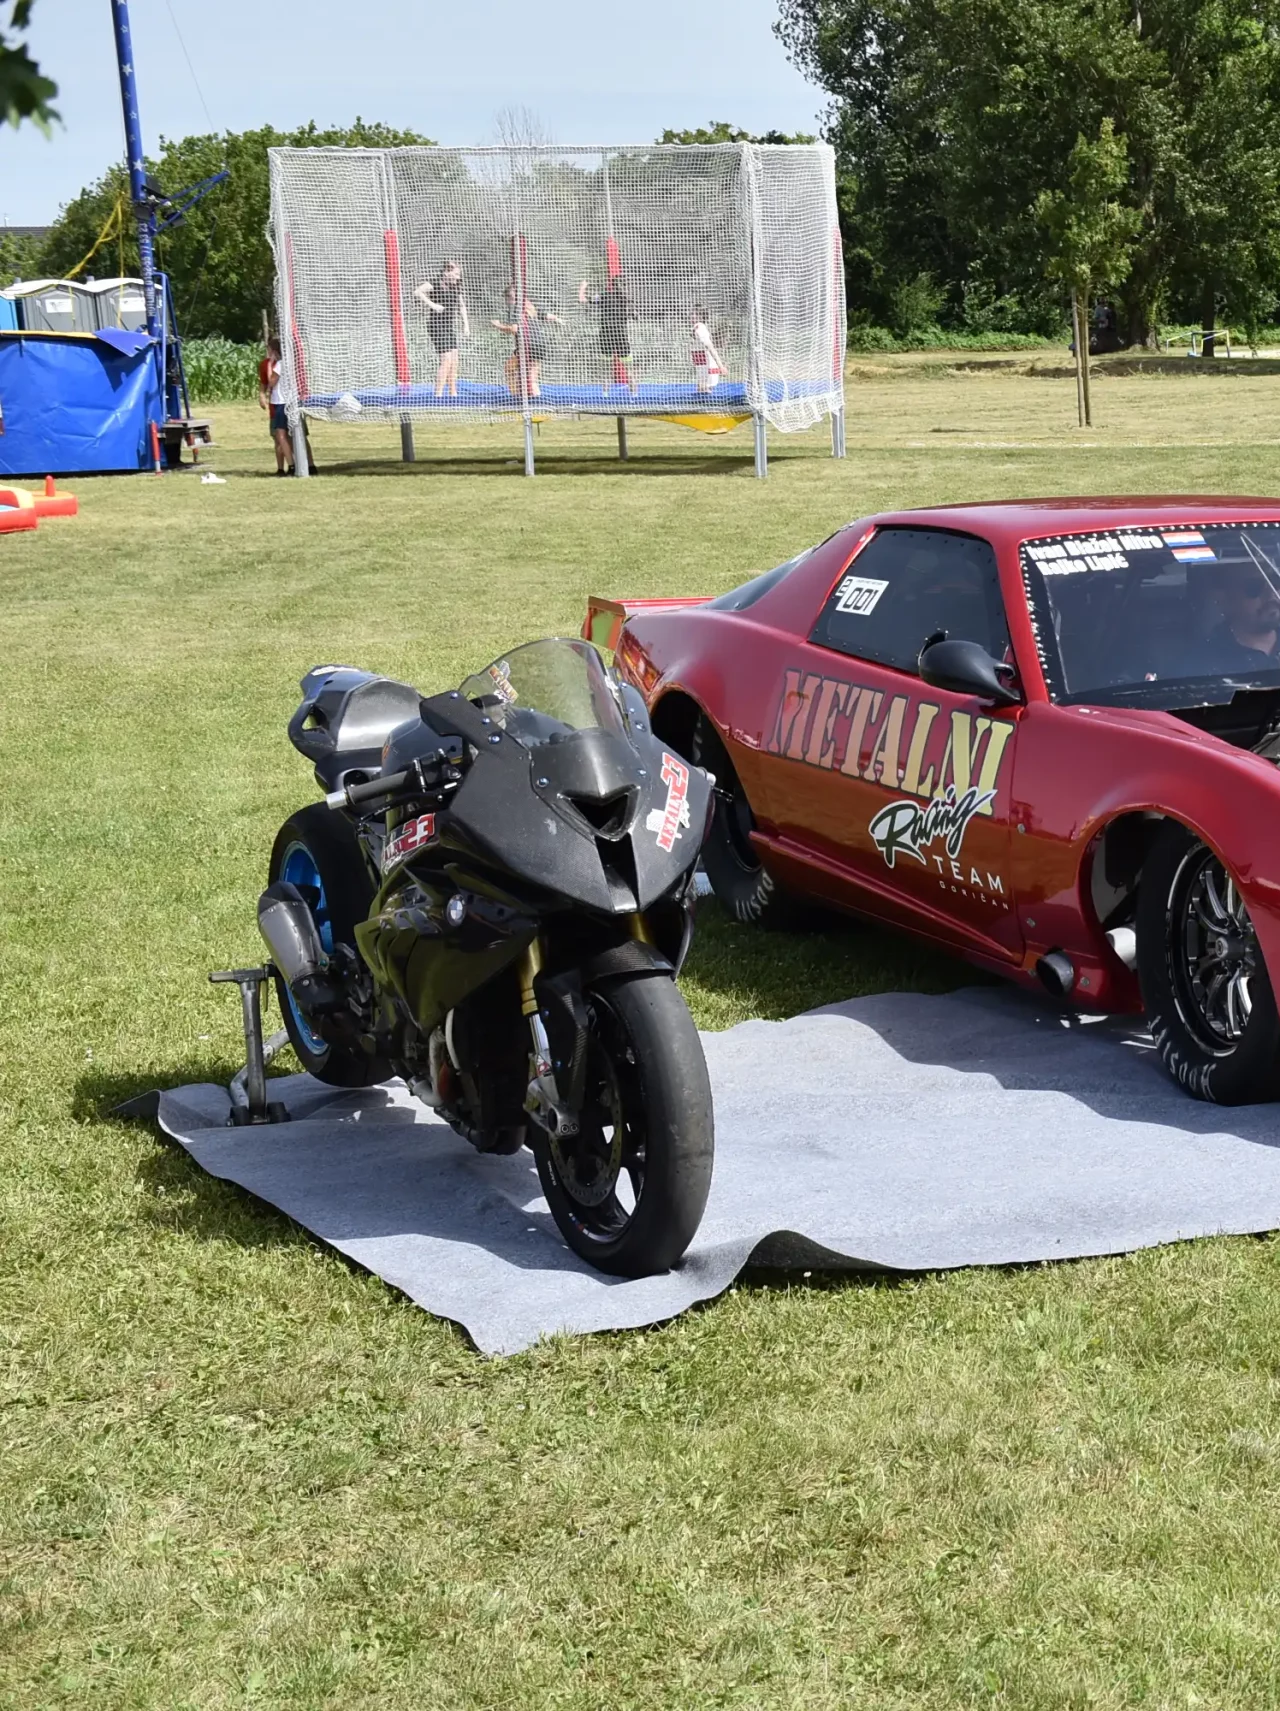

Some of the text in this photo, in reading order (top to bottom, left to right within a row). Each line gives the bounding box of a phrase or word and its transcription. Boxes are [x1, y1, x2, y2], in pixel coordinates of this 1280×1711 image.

[1026, 543, 1067, 560] Ivan
[1036, 552, 1129, 576] Rajko Lipić
[842, 587, 879, 612] 001
[768, 669, 1016, 816] METALNI
[661, 752, 689, 798] 23
[400, 813, 435, 853] 23
[869, 784, 997, 868] Racing
[932, 854, 1004, 894] TEAM
[939, 880, 1009, 911] GORIČAN
